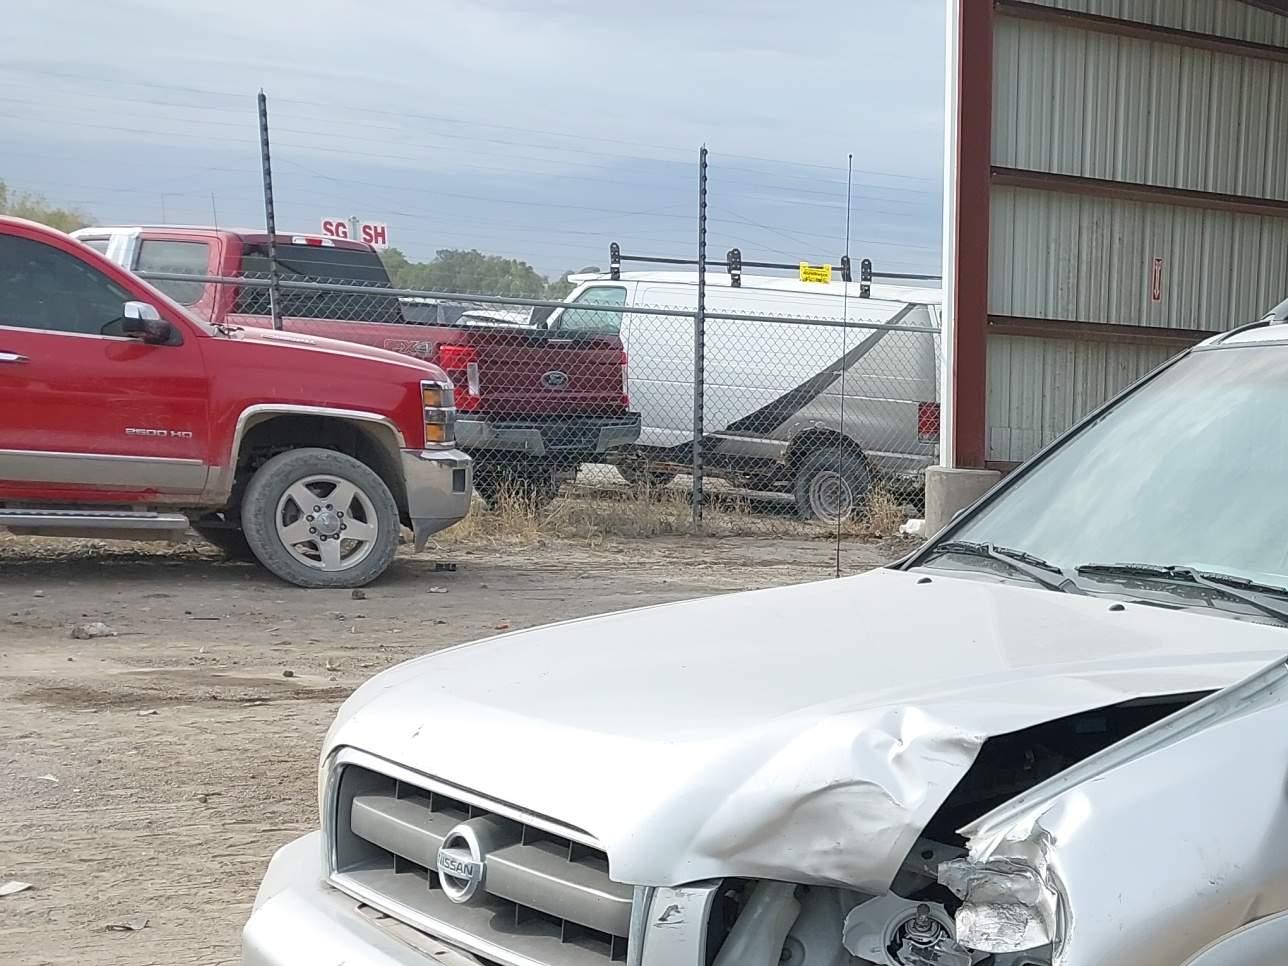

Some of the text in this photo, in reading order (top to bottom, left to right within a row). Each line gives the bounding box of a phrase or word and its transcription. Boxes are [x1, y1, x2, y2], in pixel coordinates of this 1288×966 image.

[362, 224, 386, 244] SH
[124, 427, 168, 437] 2500
[438, 853, 473, 876] NISSAN
